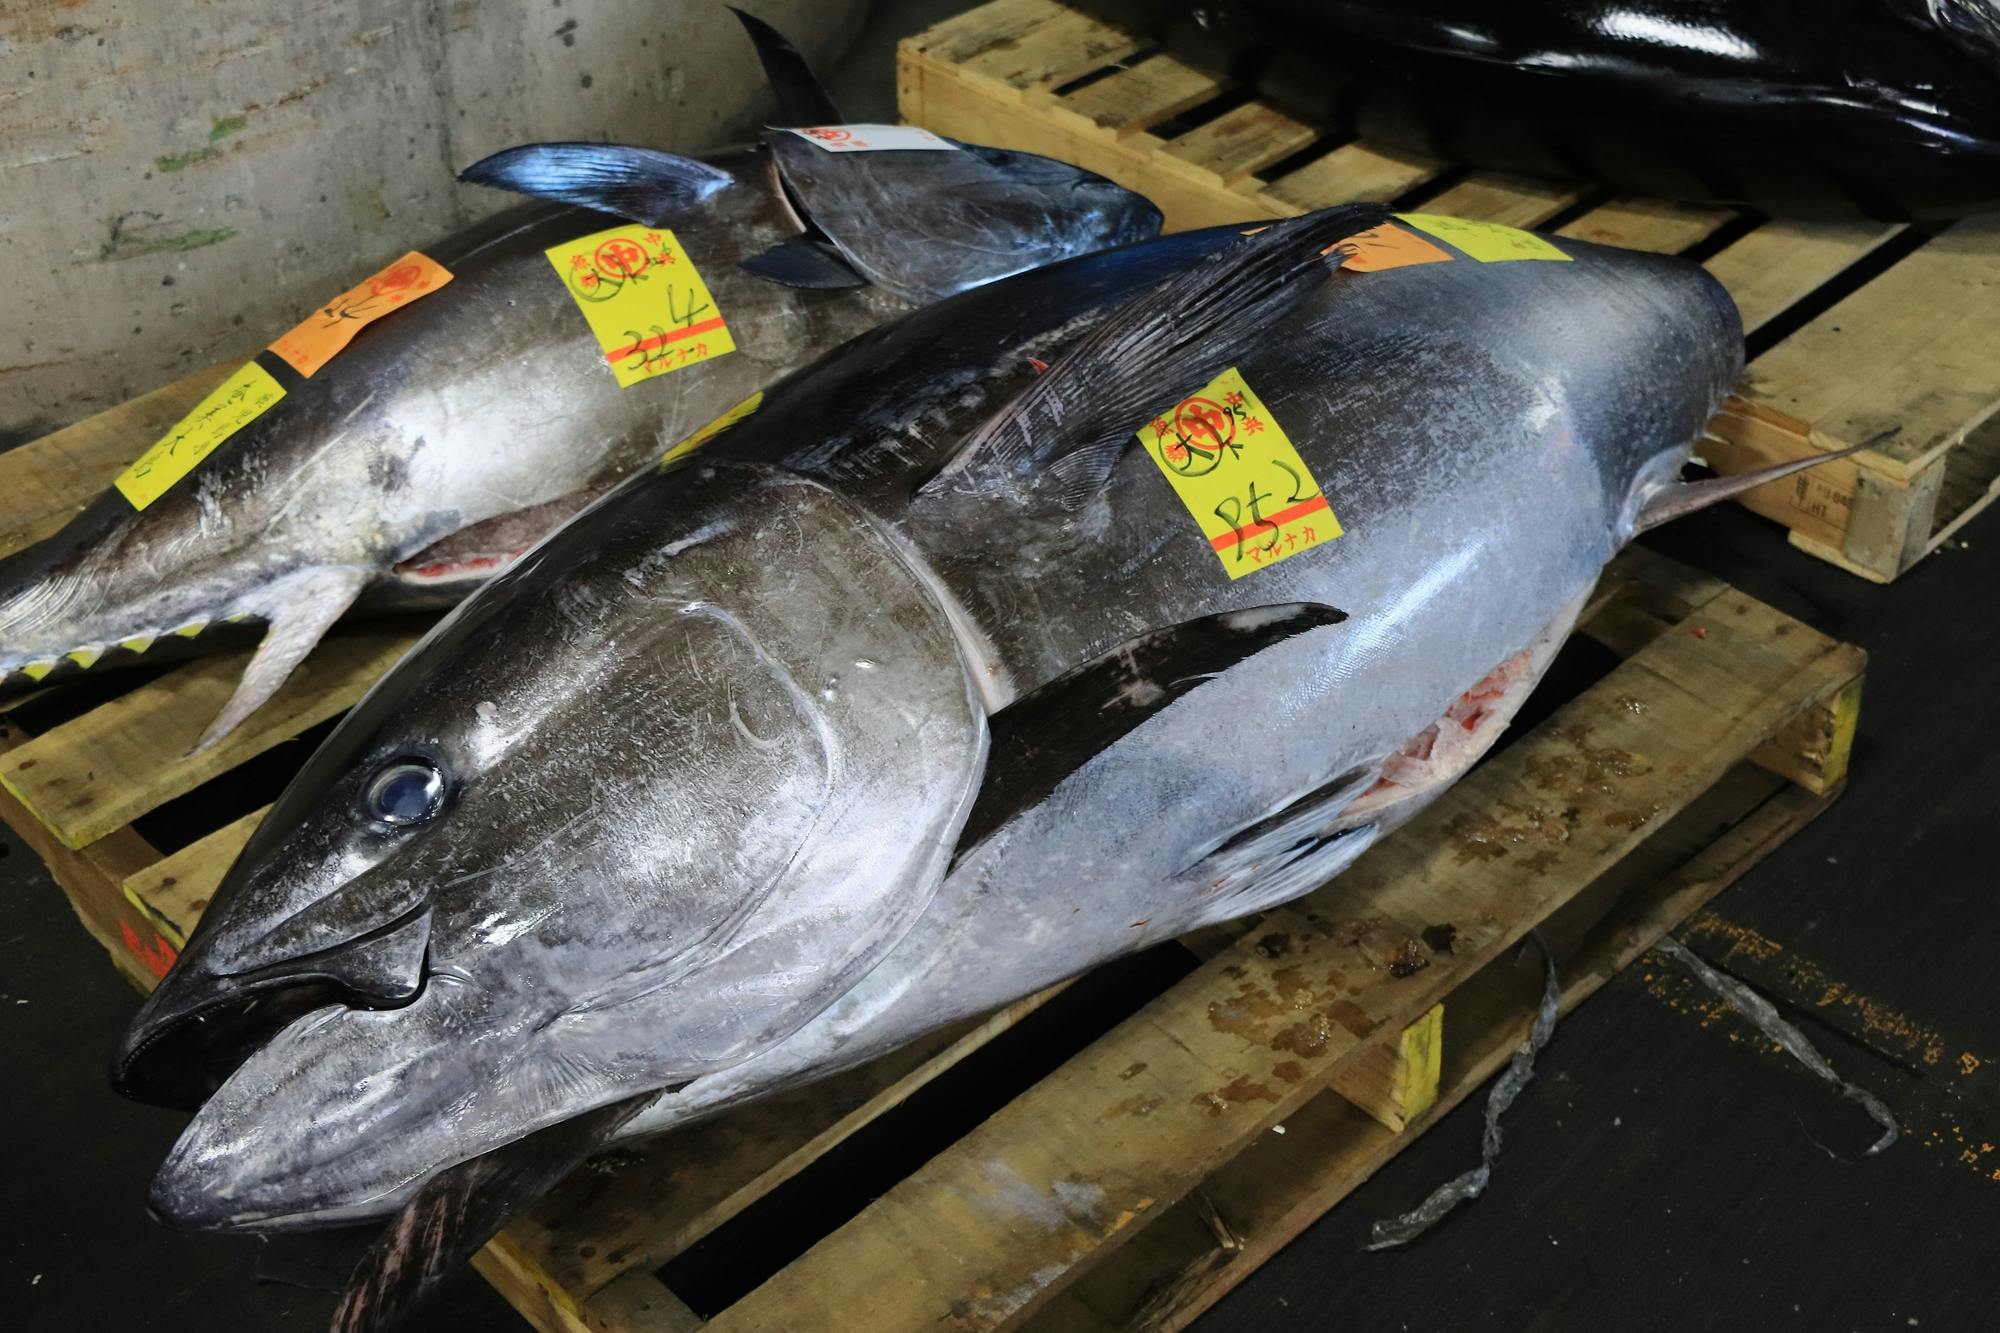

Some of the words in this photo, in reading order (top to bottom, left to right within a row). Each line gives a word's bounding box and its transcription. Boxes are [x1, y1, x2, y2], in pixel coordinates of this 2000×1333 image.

[624, 284, 709, 370] 324
[1245, 526, 1316, 562] マルナカ
